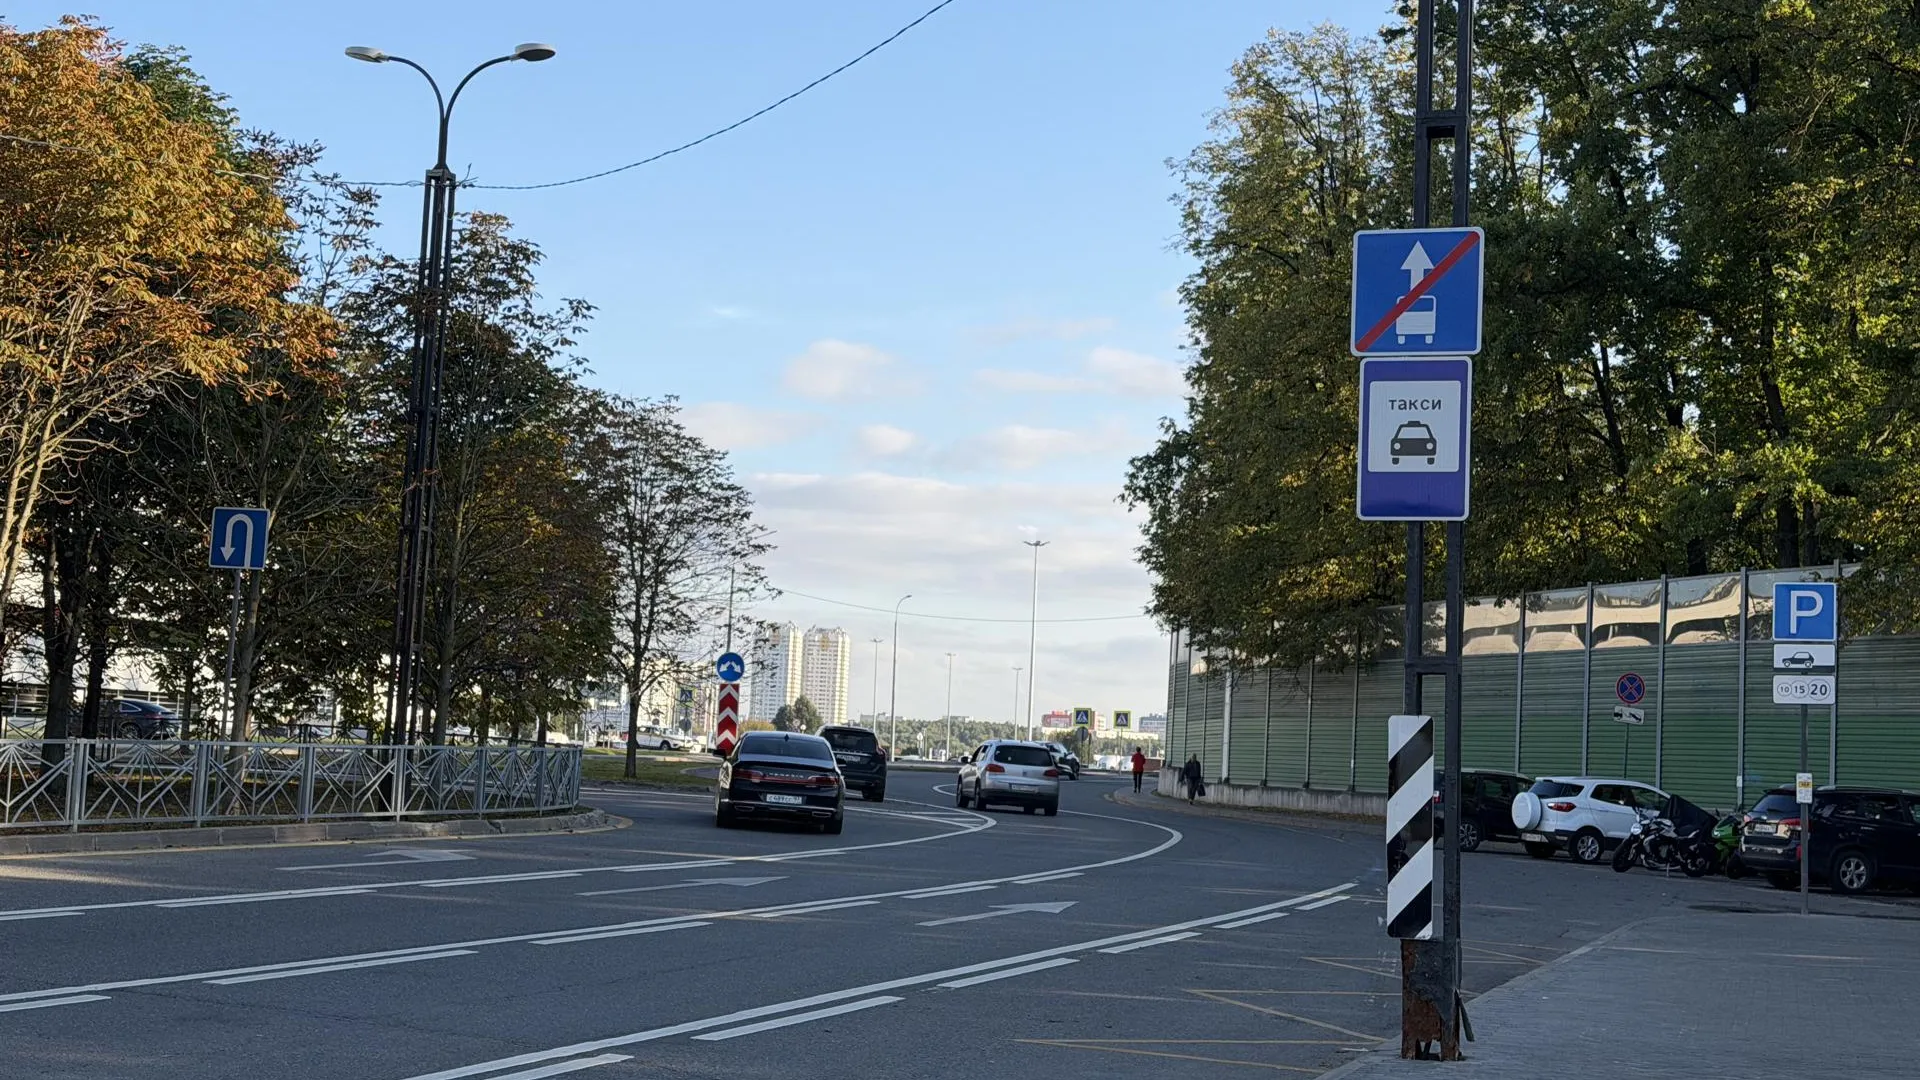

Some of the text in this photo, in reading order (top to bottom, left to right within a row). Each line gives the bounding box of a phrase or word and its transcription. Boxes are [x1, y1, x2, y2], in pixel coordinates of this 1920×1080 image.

[1388, 399, 1442, 411] такси
[1790, 590, 1823, 634] P
[1794, 685, 1806, 694] 15
[1810, 683, 1828, 696] 20
